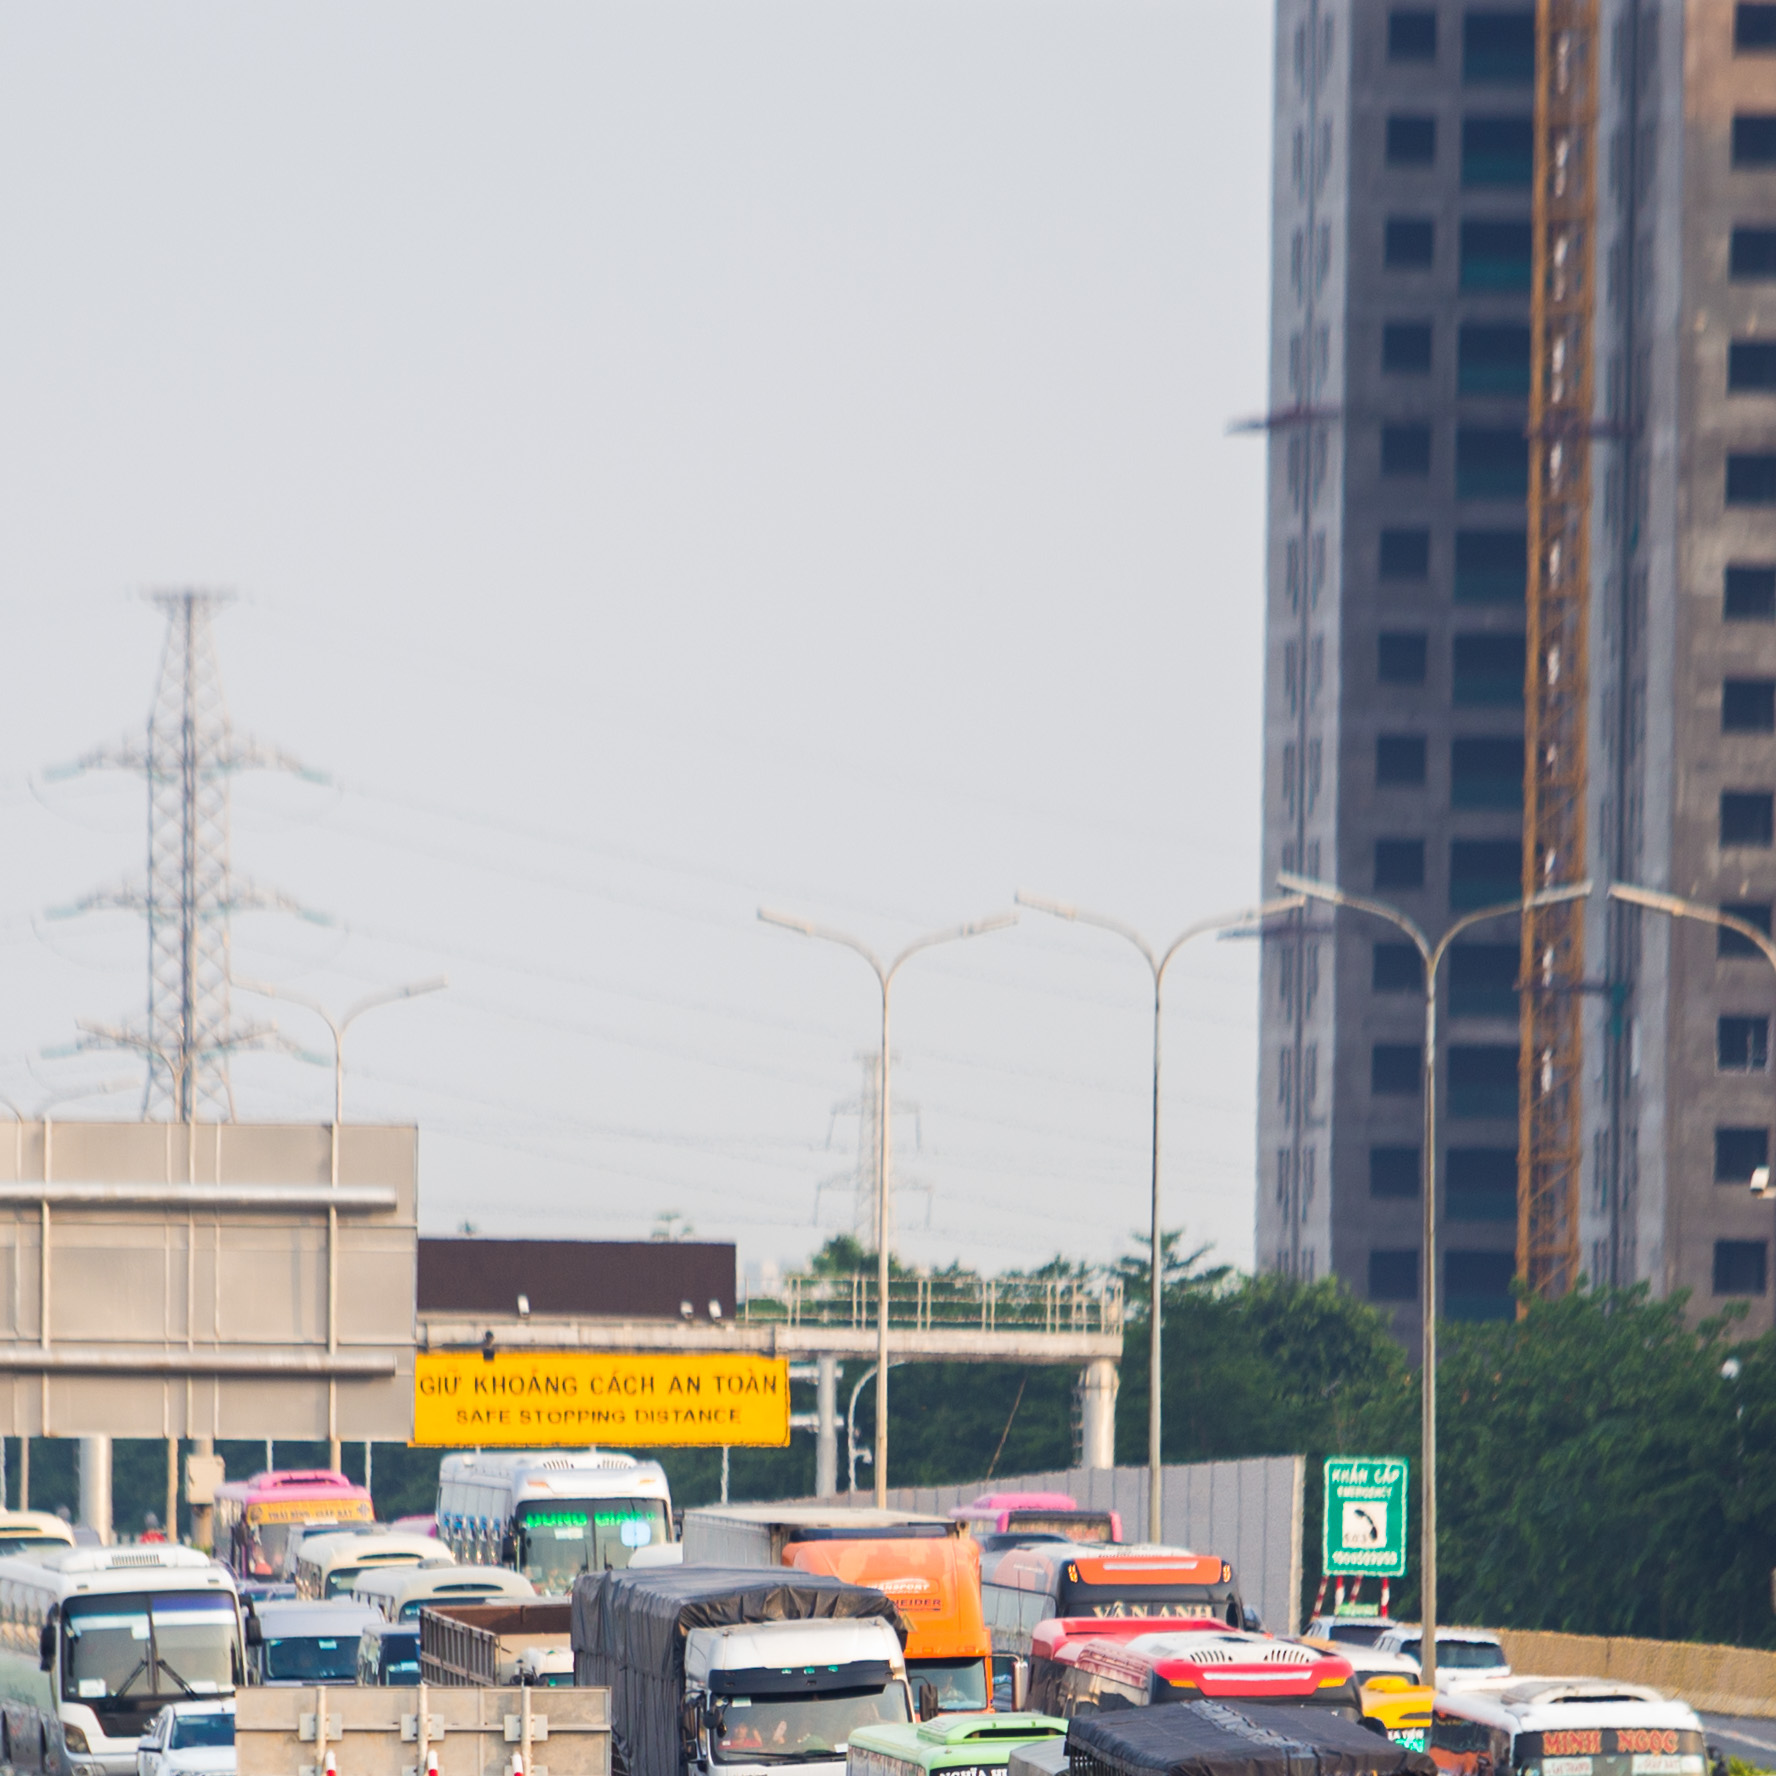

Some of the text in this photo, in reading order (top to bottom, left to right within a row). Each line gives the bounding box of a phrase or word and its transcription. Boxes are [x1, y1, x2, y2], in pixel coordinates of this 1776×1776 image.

[474, 1366, 578, 1397] KHOẢNG
[590, 1368, 656, 1396] CÁCH
[667, 1376, 702, 1396] AN
[712, 1367, 778, 1396] TOÀN
[455, 1408, 742, 1425] SAFE STOPPING DISTANCE
[1336, 1485, 1393, 1498] EMERGENCY
[1092, 1601, 1212, 1618] VÂN ANH
[1542, 1729, 1679, 1757] MINH NGỌC
